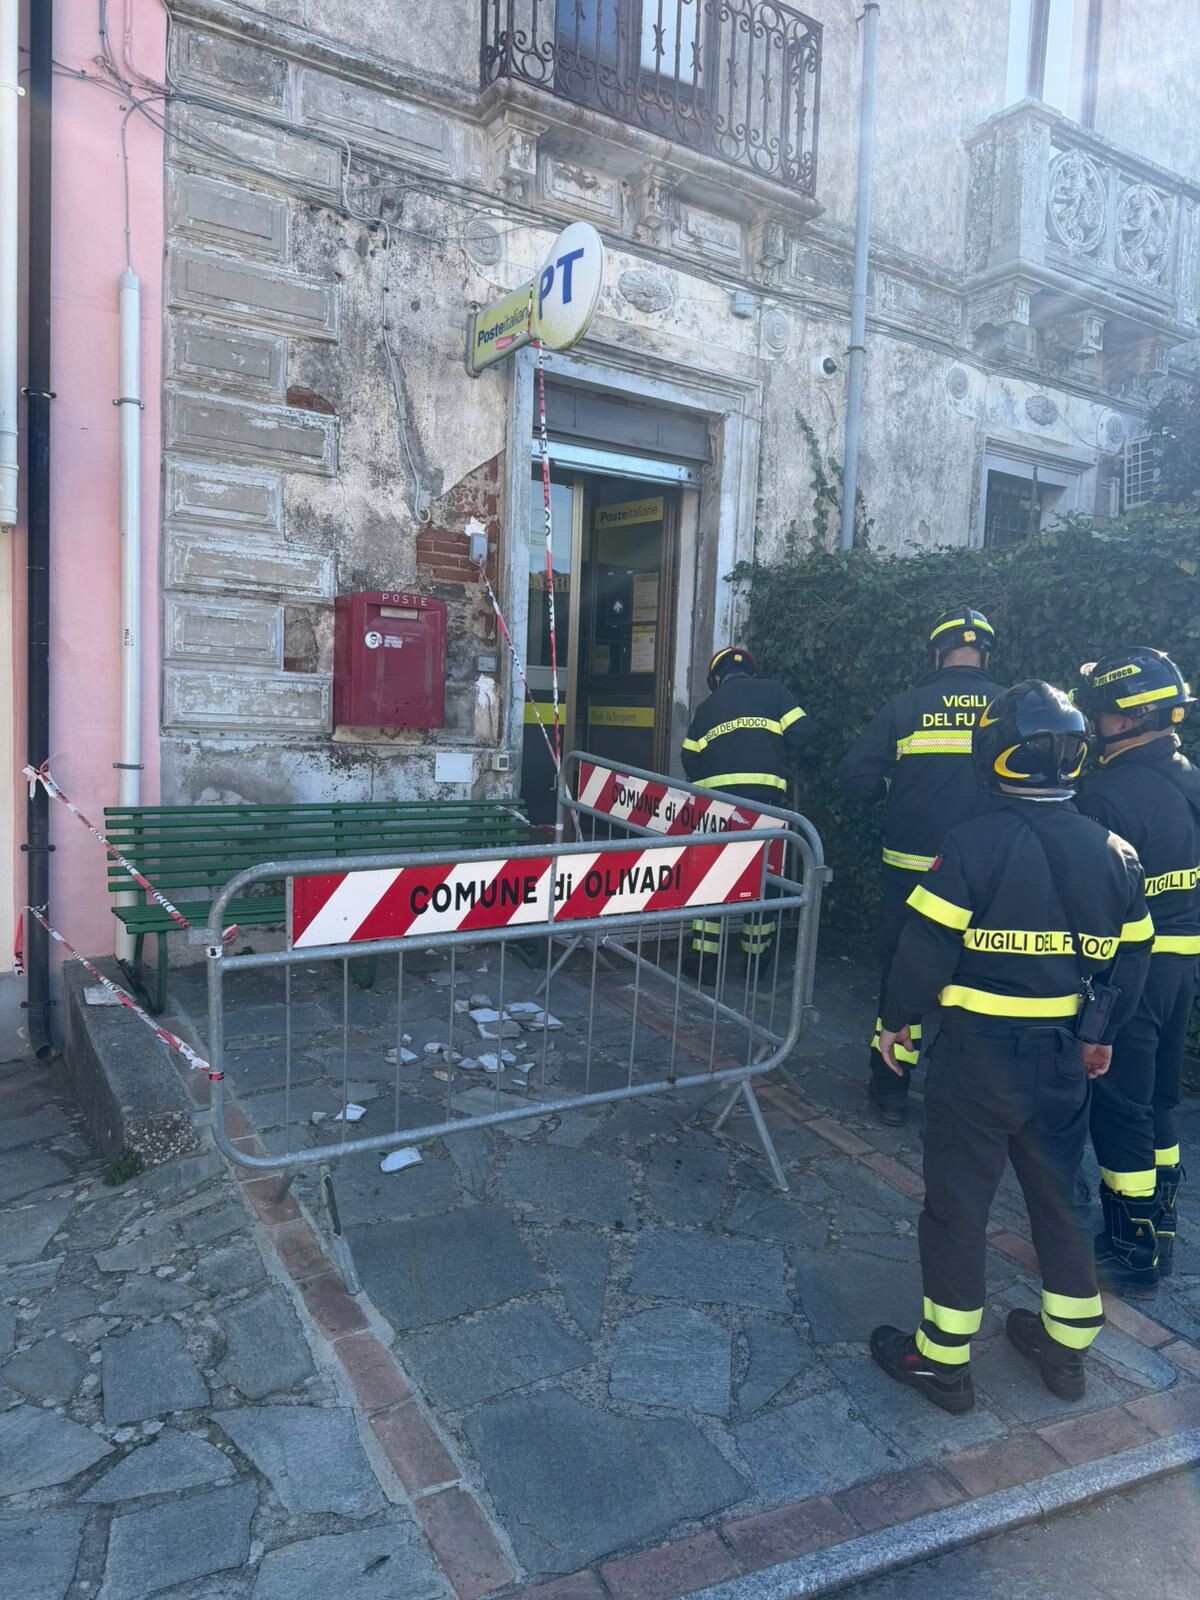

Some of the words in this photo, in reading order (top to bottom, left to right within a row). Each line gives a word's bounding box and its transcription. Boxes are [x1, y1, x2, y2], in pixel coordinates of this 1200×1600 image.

[539, 248, 584, 320] PT
[478, 306, 529, 347] Posteitalian
[382, 593, 428, 606] POSTE
[1108, 667, 1133, 681] FUOCO
[943, 695, 987, 707] VIGILI
[720, 722, 736, 733] DEL
[737, 718, 768, 727] FUOCO
[923, 713, 952, 727] DEL
[613, 785, 660, 818] COMUNE
[666, 802, 675, 822] di
[682, 806, 732, 834] OLIVADI
[410, 875, 538, 915] COMUNE
[555, 873, 572, 902] di
[585, 864, 681, 898] OLIVADI
[974, 932, 1027, 951] VIGILI
[1035, 934, 1058, 952] DEL
